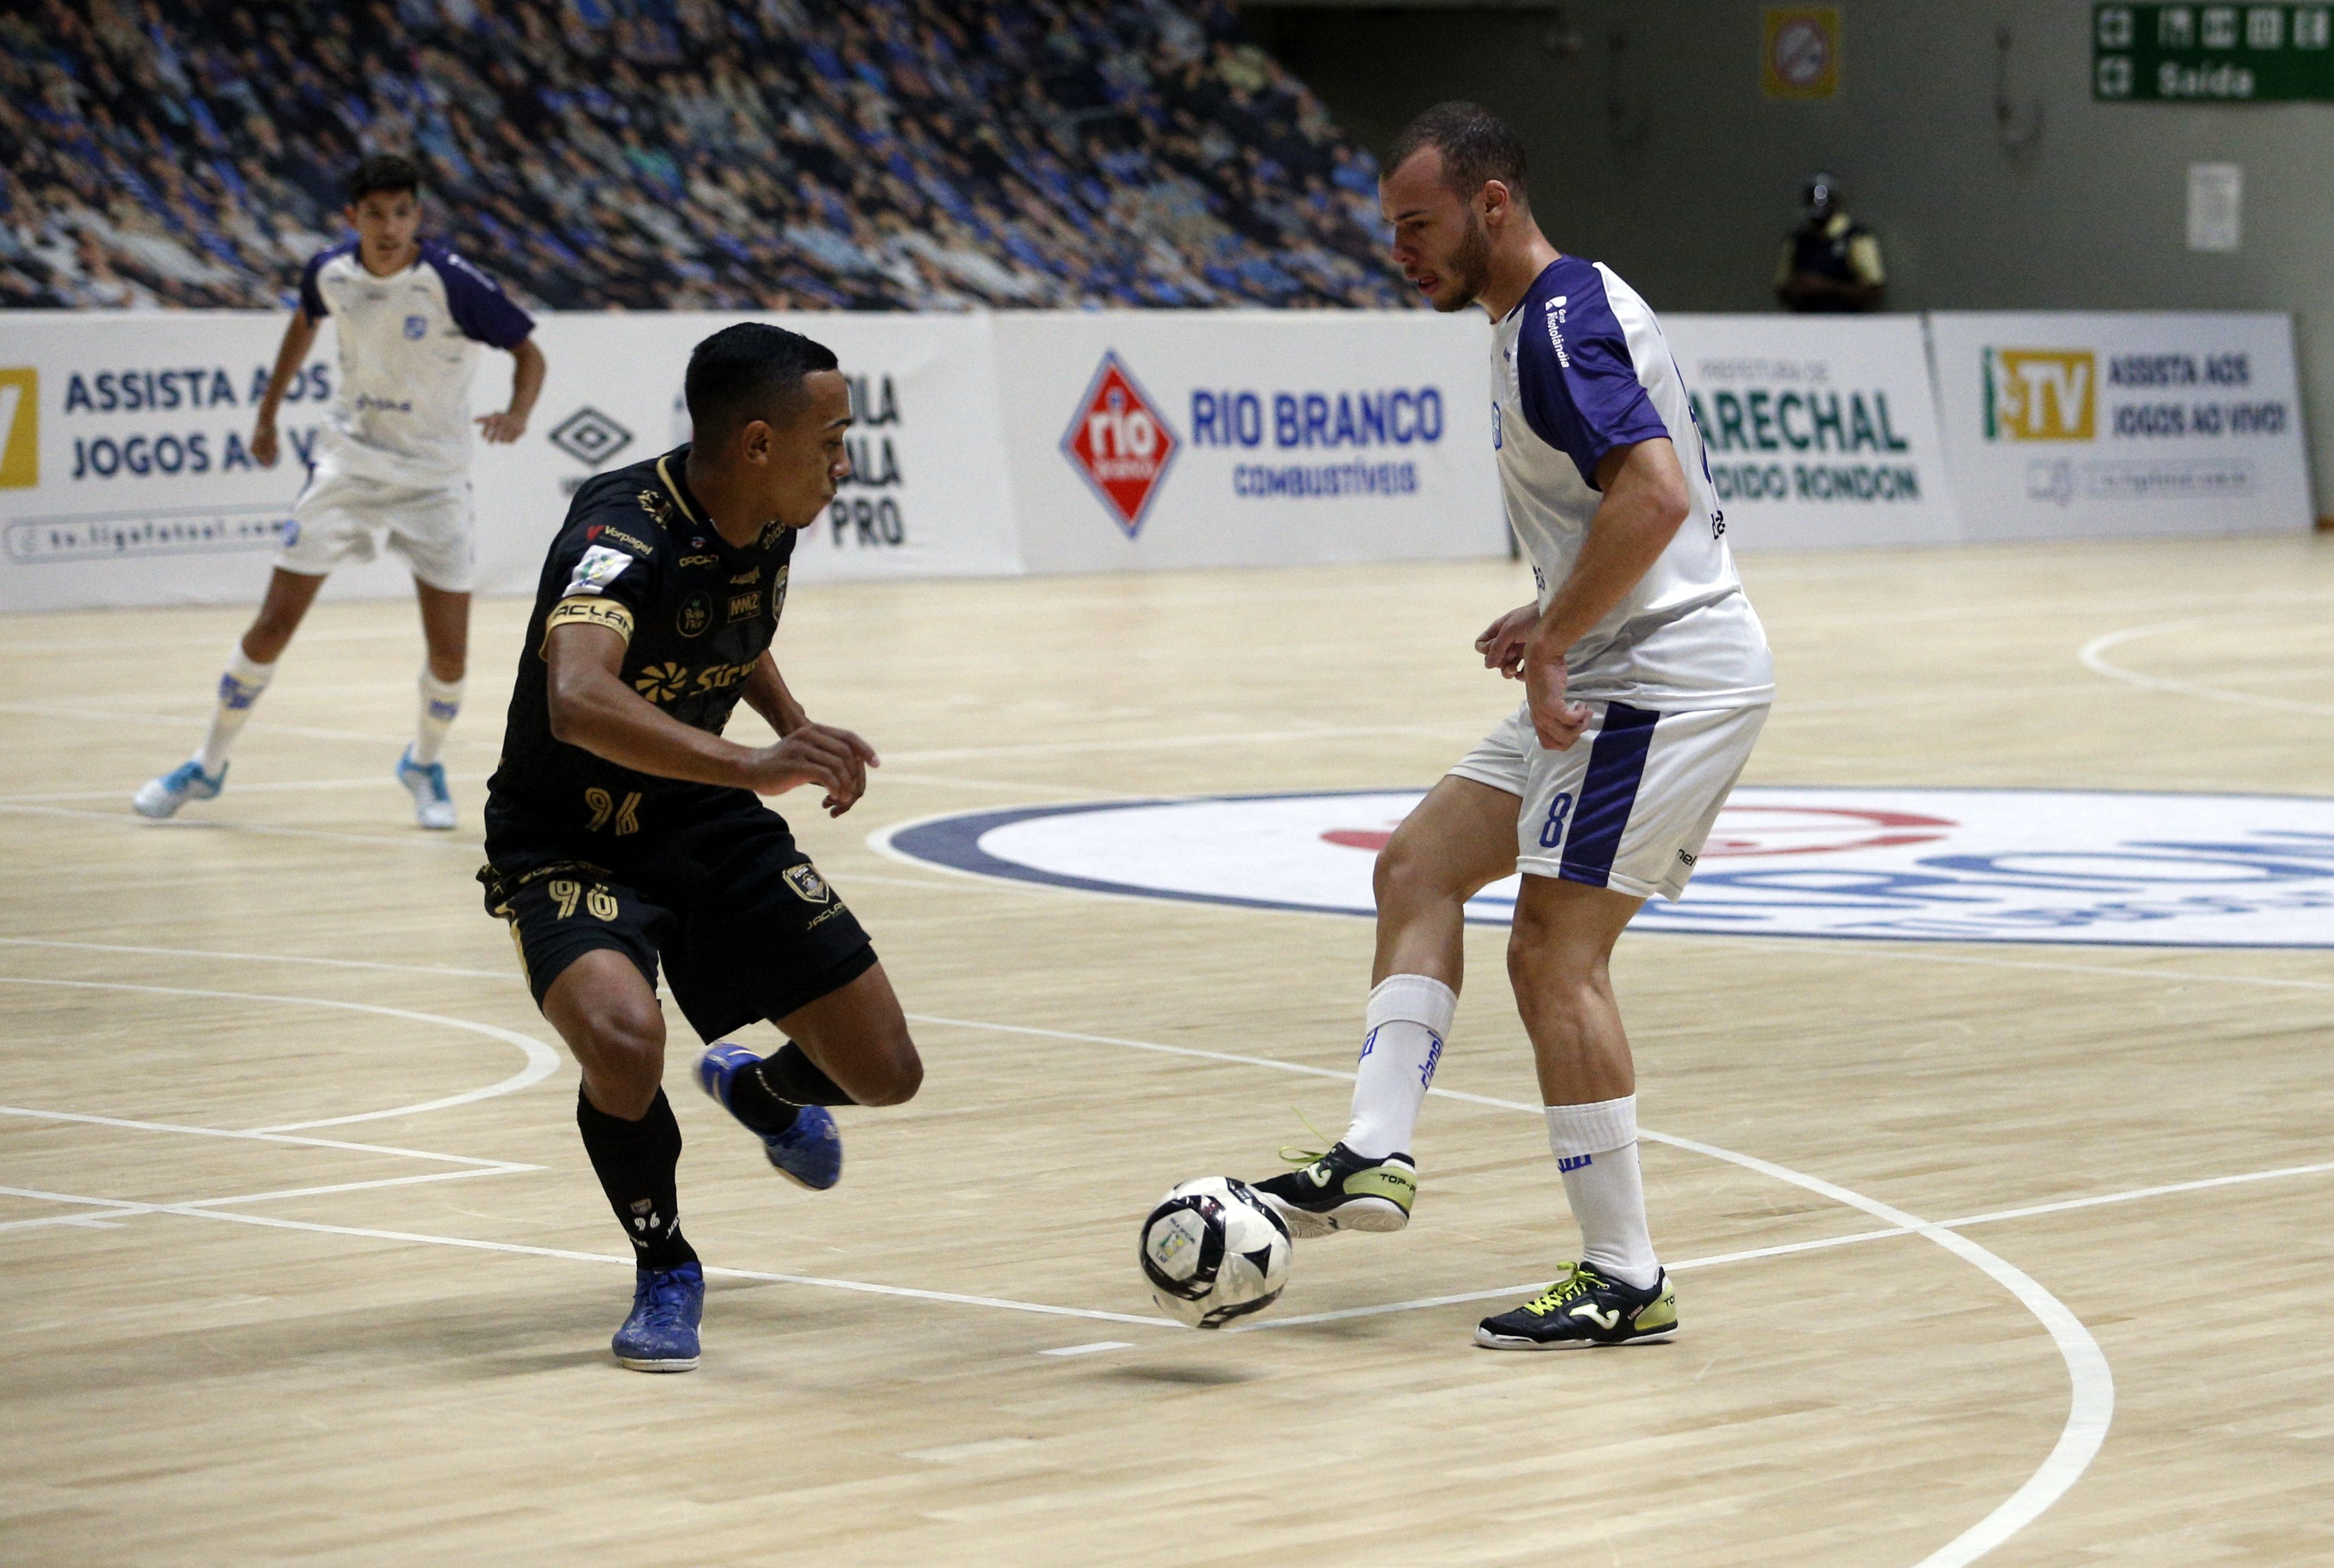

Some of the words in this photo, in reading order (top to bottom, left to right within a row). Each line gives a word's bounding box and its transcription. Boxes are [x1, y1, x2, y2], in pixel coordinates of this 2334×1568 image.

[1546, 311, 1571, 368] Risotolândia
[64, 369, 236, 415] ASSISTA
[2109, 355, 2197, 387] ASSISTA
[2203, 352, 2250, 385] AOS
[1190, 390, 1262, 448] RIO
[1272, 386, 1444, 449] BRANCO
[1689, 389, 1908, 453] ARECHAL
[2192, 404, 2222, 435] AO
[73, 434, 212, 479] JOGOS
[1793, 465, 1922, 502] RONDON
[829, 496, 904, 548] PRO
[1539, 792, 1572, 848] 8
[548, 880, 619, 922] 96
[634, 1211, 660, 1231] 96
